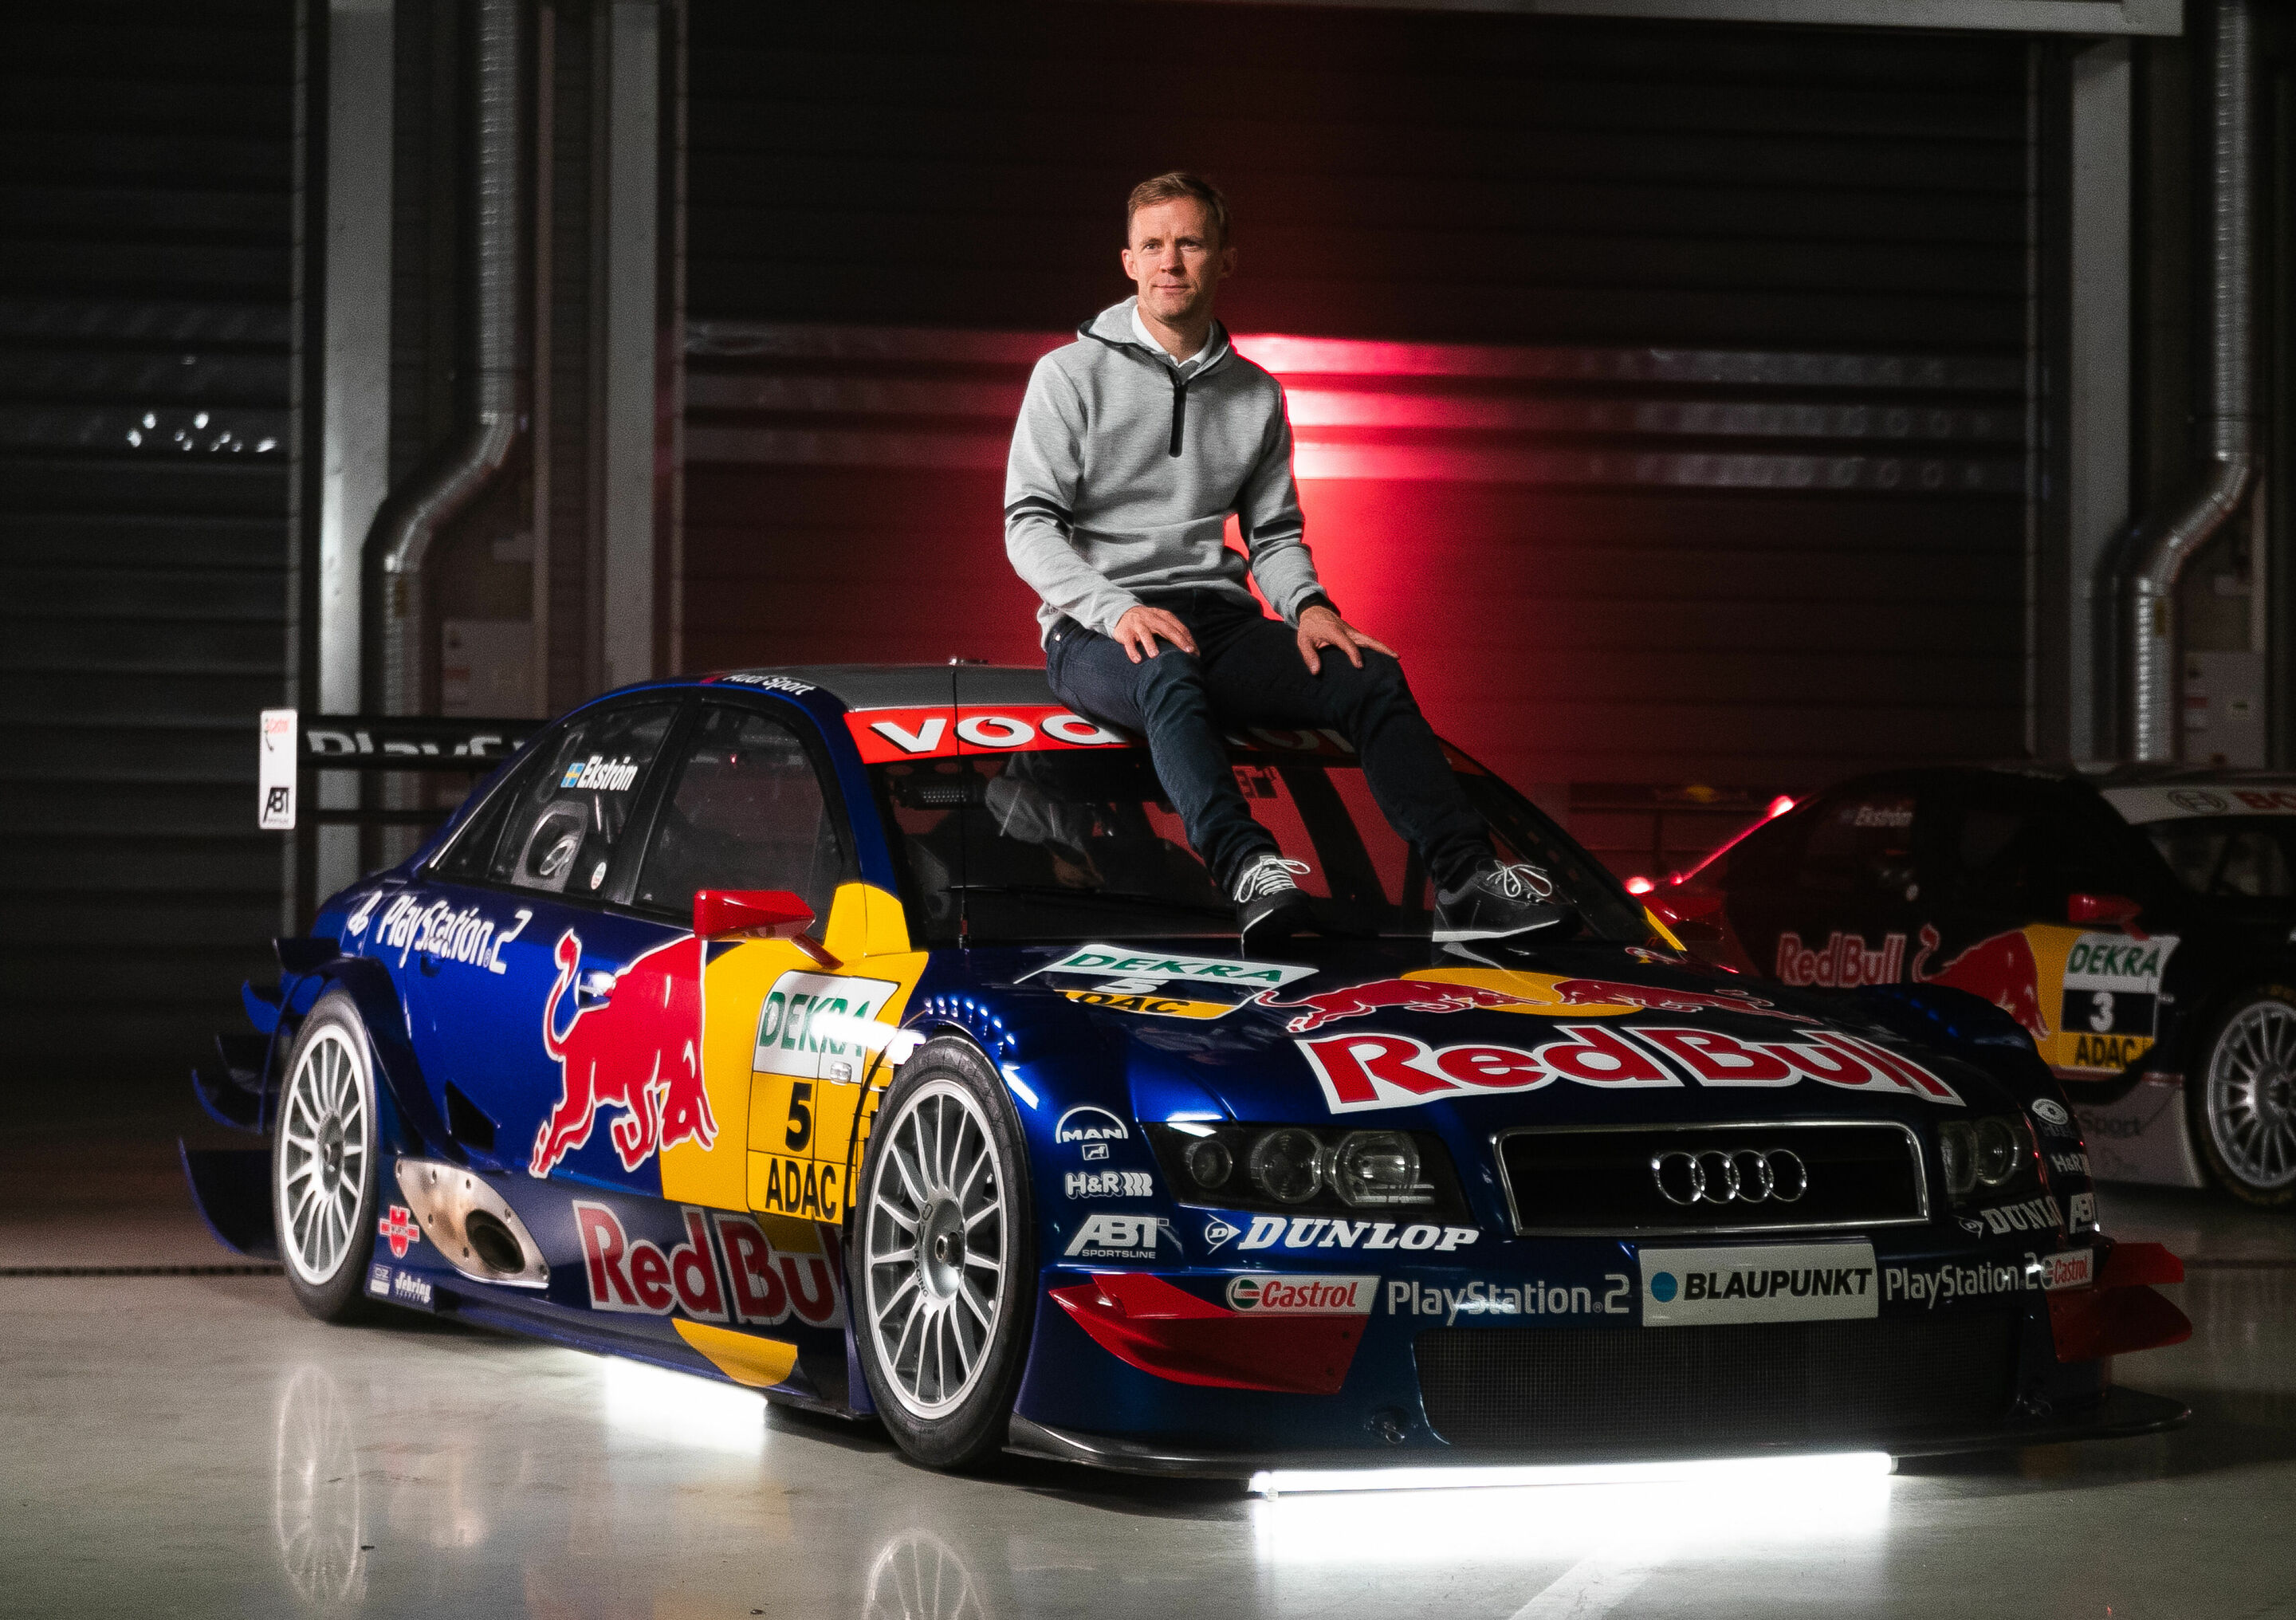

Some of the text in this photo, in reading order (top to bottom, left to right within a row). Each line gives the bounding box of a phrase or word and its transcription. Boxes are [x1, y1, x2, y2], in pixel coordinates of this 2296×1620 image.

[761, 676, 817, 696] Sport
[576, 756, 638, 791] Ekström
[263, 787, 289, 822] ABT
[1060, 954, 1282, 983] DEKRA
[1776, 931, 1908, 989] Red Bull
[2068, 944, 2161, 977] DEKRA
[1091, 977, 1170, 994] 5
[1076, 993, 1191, 1013] DAC
[2089, 992, 2114, 1026] 3
[759, 992, 871, 1057] DEKRA
[2074, 1036, 2136, 1067] ADAC
[1294, 1025, 1968, 1115] Red Bull
[785, 1081, 812, 1153] 5
[1062, 1129, 1123, 1142] MAN
[2050, 1153, 2083, 1174] H&R
[765, 1158, 837, 1221] ADAC
[1066, 1172, 1124, 1198] H&R
[1063, 1214, 1158, 1256] ABT
[1237, 1217, 1480, 1251] DUNLOP
[572, 1200, 847, 1328] Red Bul
[1082, 1248, 1157, 1260] SPORTSLINE
[2054, 1256, 2089, 1284] Castrol
[914, 1249, 930, 1298] RACING
[1684, 1268, 1873, 1301] BLAUPUNKT
[1885, 1261, 2019, 1310] PlayStation
[1261, 1280, 1358, 1308] Castrol
